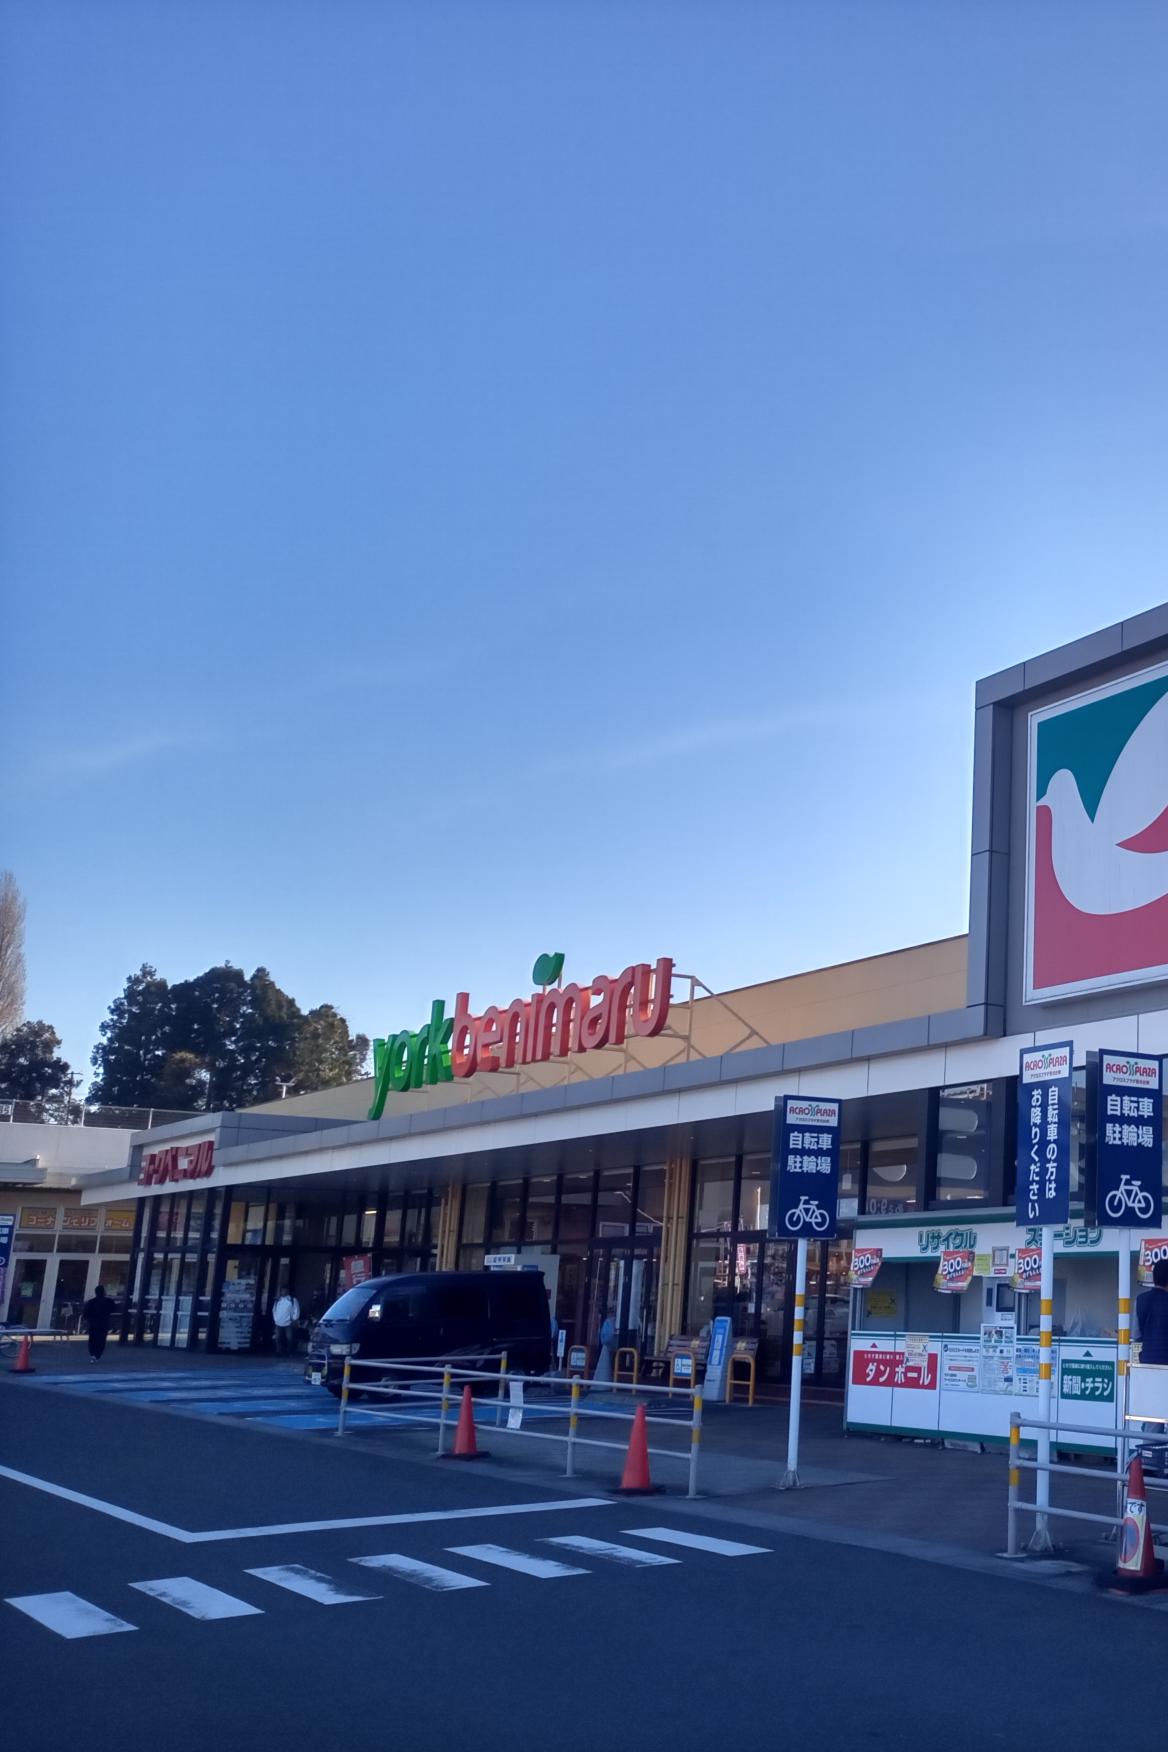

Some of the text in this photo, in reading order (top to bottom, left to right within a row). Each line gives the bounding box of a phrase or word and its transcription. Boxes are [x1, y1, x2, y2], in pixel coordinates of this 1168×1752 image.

[368, 953, 673, 1120] york benimaru
[1107, 1094, 1154, 1118] 自転車
[789, 1131, 832, 1150] 自転車
[1046, 1086, 1059, 1199] 自転車の方は
[1105, 1123, 1153, 1147] 駐輪場
[138, 1140, 214, 1186] ヨークベニマル
[787, 1155, 832, 1174] 駐輪場
[1028, 1089, 1042, 1219] お降りください
[918, 1228, 978, 1253] リサイクル
[853, 1254, 871, 1270] 300
[942, 1257, 962, 1275] 300
[1018, 1255, 1039, 1273] 300
[1145, 1245, 1168, 1266] 300
[866, 1362, 931, 1385] ダンボール
